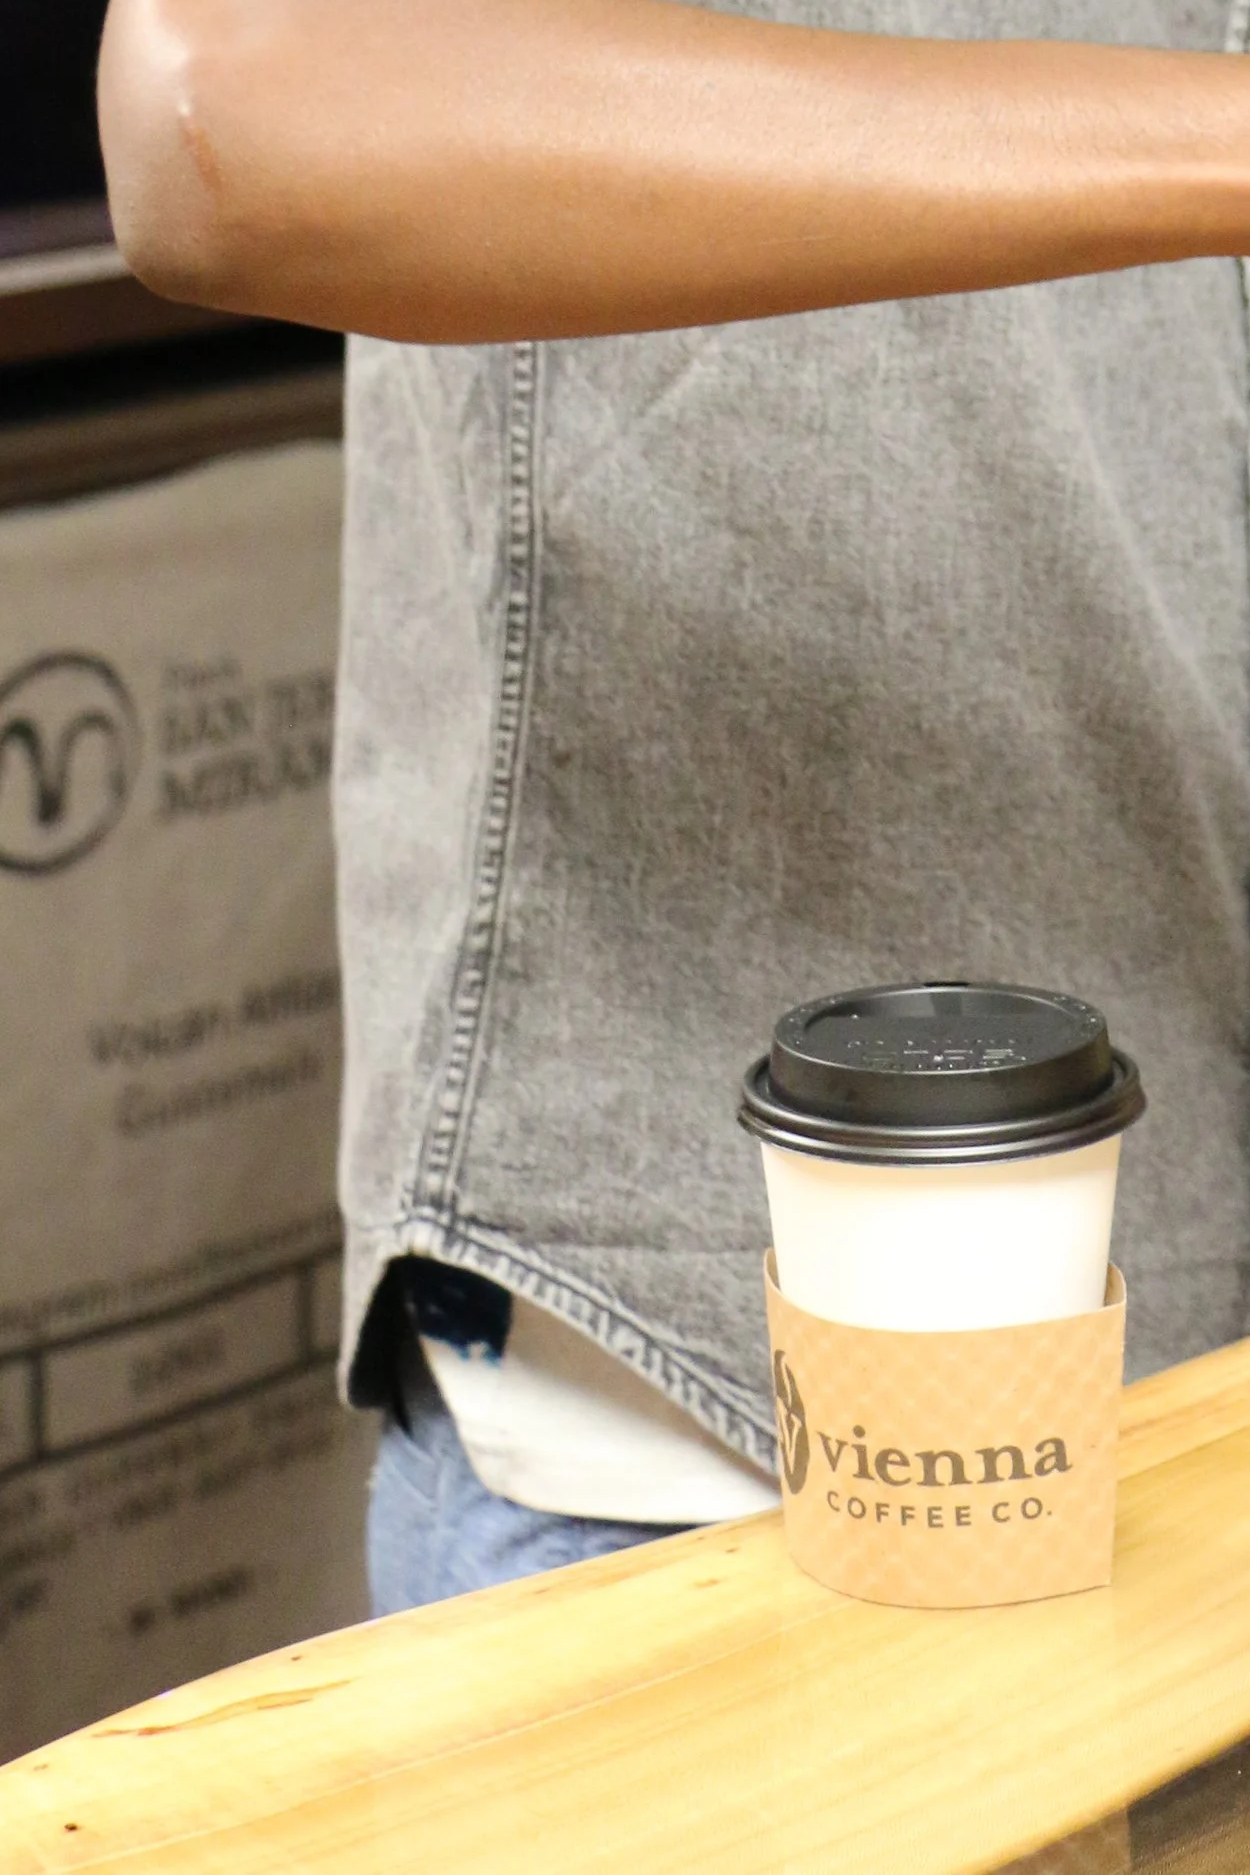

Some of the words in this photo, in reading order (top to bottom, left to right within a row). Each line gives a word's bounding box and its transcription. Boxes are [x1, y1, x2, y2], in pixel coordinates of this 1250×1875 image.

[815, 1424, 1073, 1487] vienna
[826, 1490, 972, 1528] COFFEE
[991, 1496, 1053, 1523] CO.
